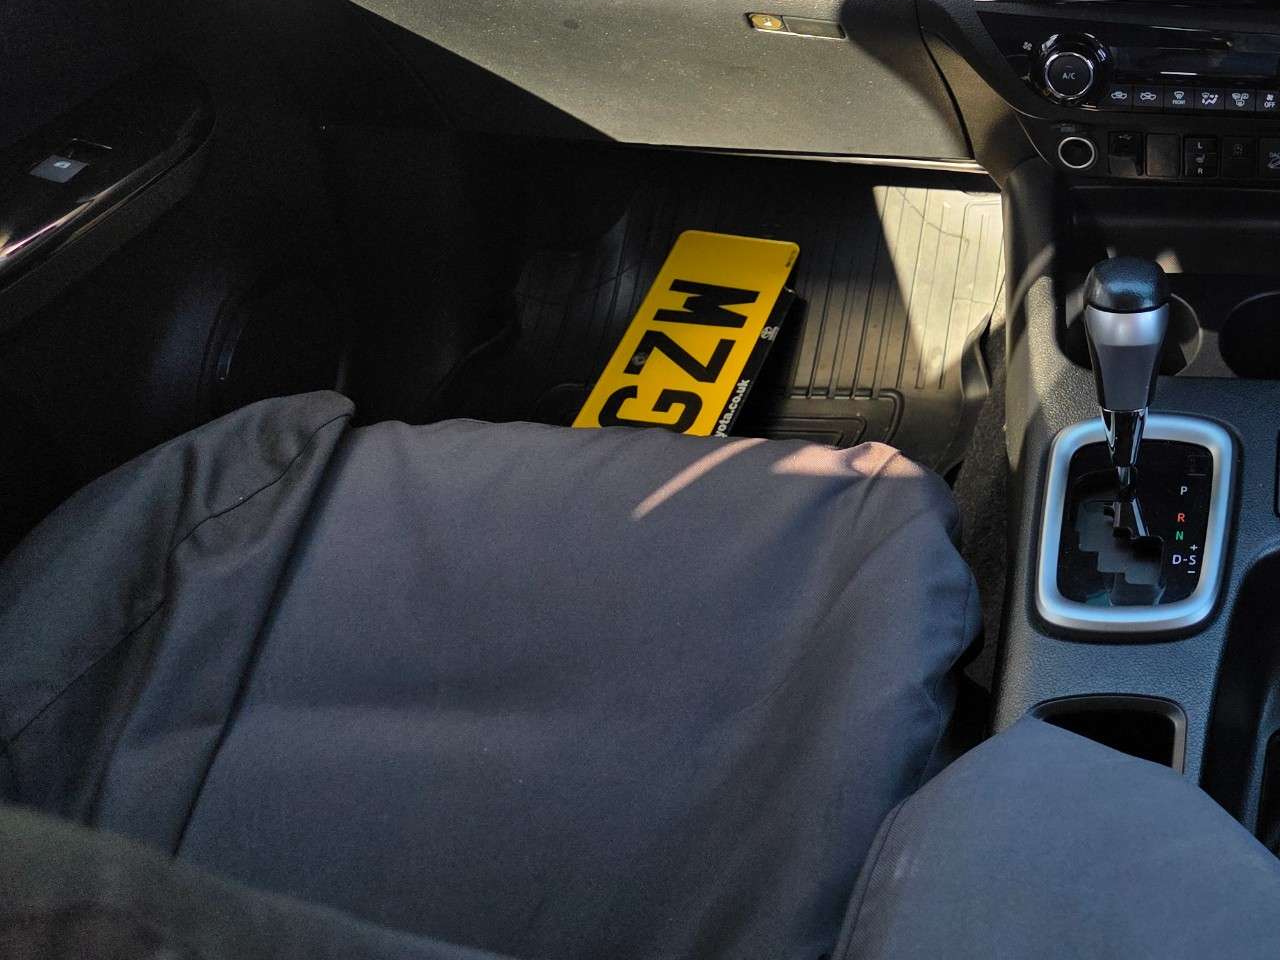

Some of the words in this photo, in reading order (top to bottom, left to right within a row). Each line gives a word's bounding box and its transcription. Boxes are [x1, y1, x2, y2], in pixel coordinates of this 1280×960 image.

[1062, 72, 1076, 80] A/C
[1180, 486, 1188, 496] P
[1177, 512, 1185, 523] R
[1175, 531, 1184, 541] N
